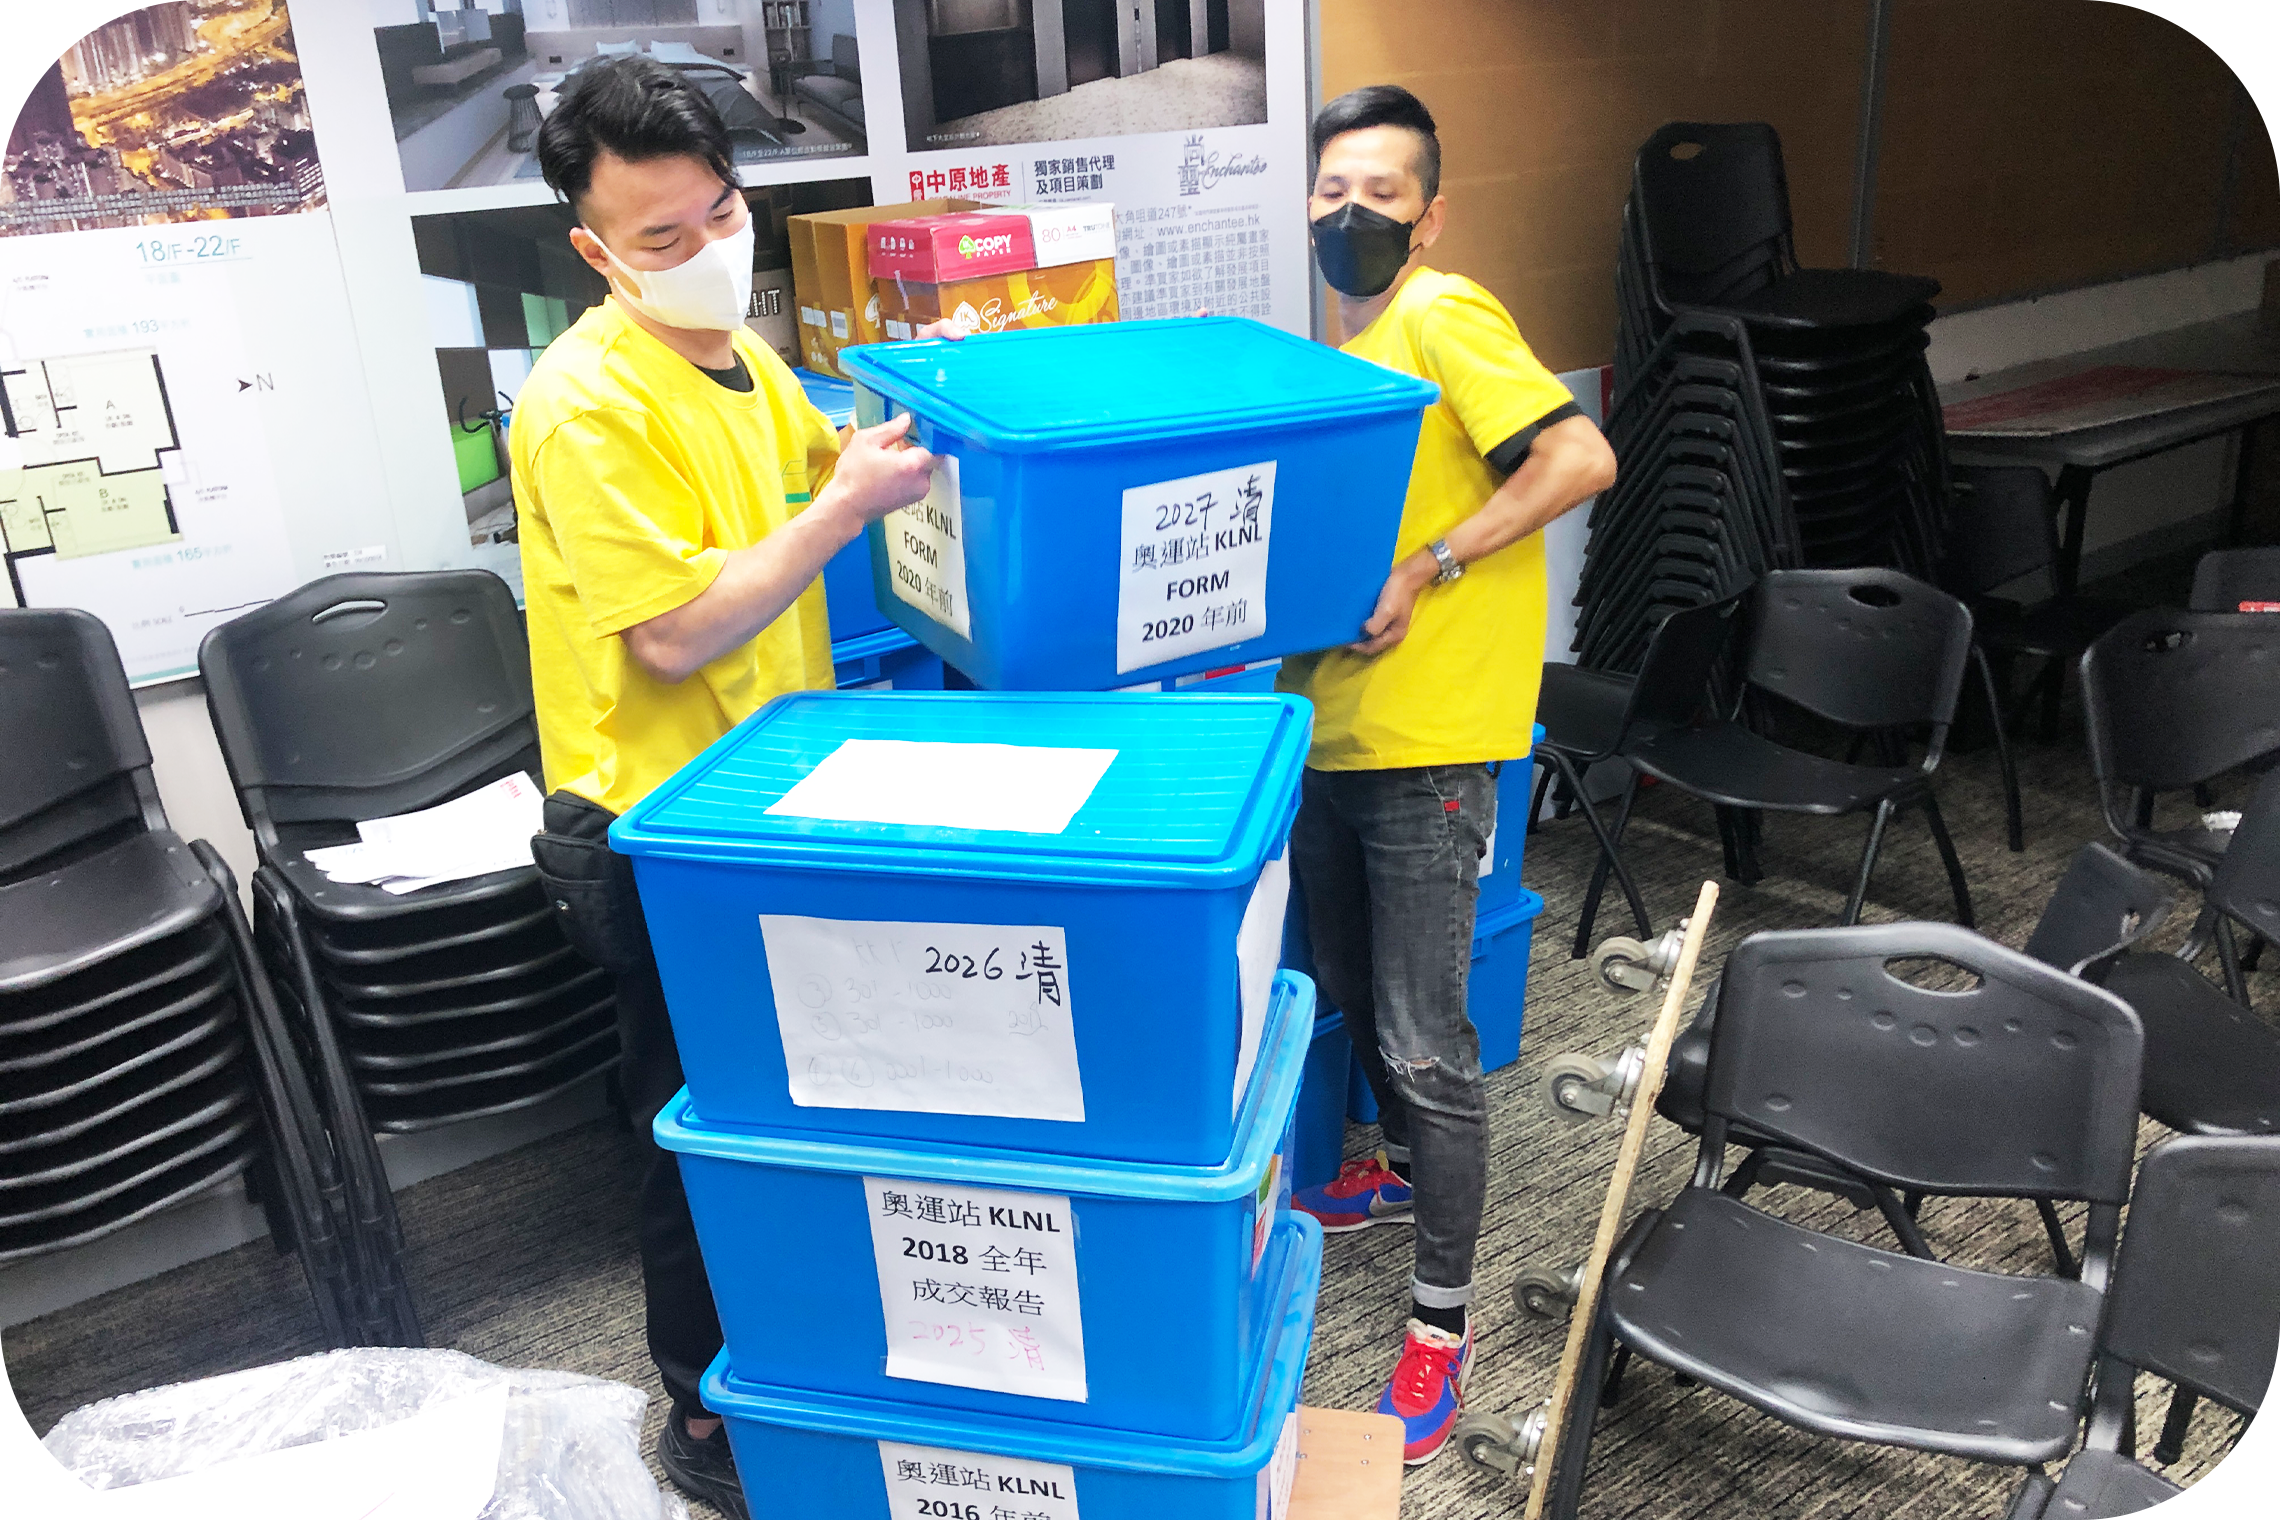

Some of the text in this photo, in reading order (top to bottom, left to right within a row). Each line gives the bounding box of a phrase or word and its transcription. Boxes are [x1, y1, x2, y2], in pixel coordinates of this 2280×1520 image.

[926, 163, 1011, 194] 中原地產
[1034, 155, 1115, 177] 獨家銷售代理
[972, 189, 1012, 200] PROPERTY
[1036, 173, 1104, 195] 及項目策劃
[1042, 227, 1061, 243] 80
[1066, 225, 1077, 233] A4
[1157, 213, 1261, 237] www.enchantee.hk
[974, 233, 1012, 252] COPY
[979, 289, 1059, 333] Signature
[255, 372, 275, 392] N
[105, 400, 116, 410] A
[926, 504, 957, 540] KLNL
[1155, 491, 1219, 531] 2027
[904, 529, 938, 569] FORM
[1132, 522, 1263, 573] 奧運站 KLNL
[897, 560, 953, 617] 2020 年前
[1166, 569, 1230, 602] FORM
[1142, 598, 1248, 642] 2020 年前
[925, 946, 1003, 980] 2026
[882, 1190, 1061, 1233] 奧運站 KLNL
[902, 1236, 1048, 1276] 2018 全年
[912, 1278, 1046, 1317] 成交報告
[908, 1320, 986, 1355] 2025
[897, 1459, 1066, 1500] 奧運站 KLNL
[916, 1498, 981, 1520] 2016
